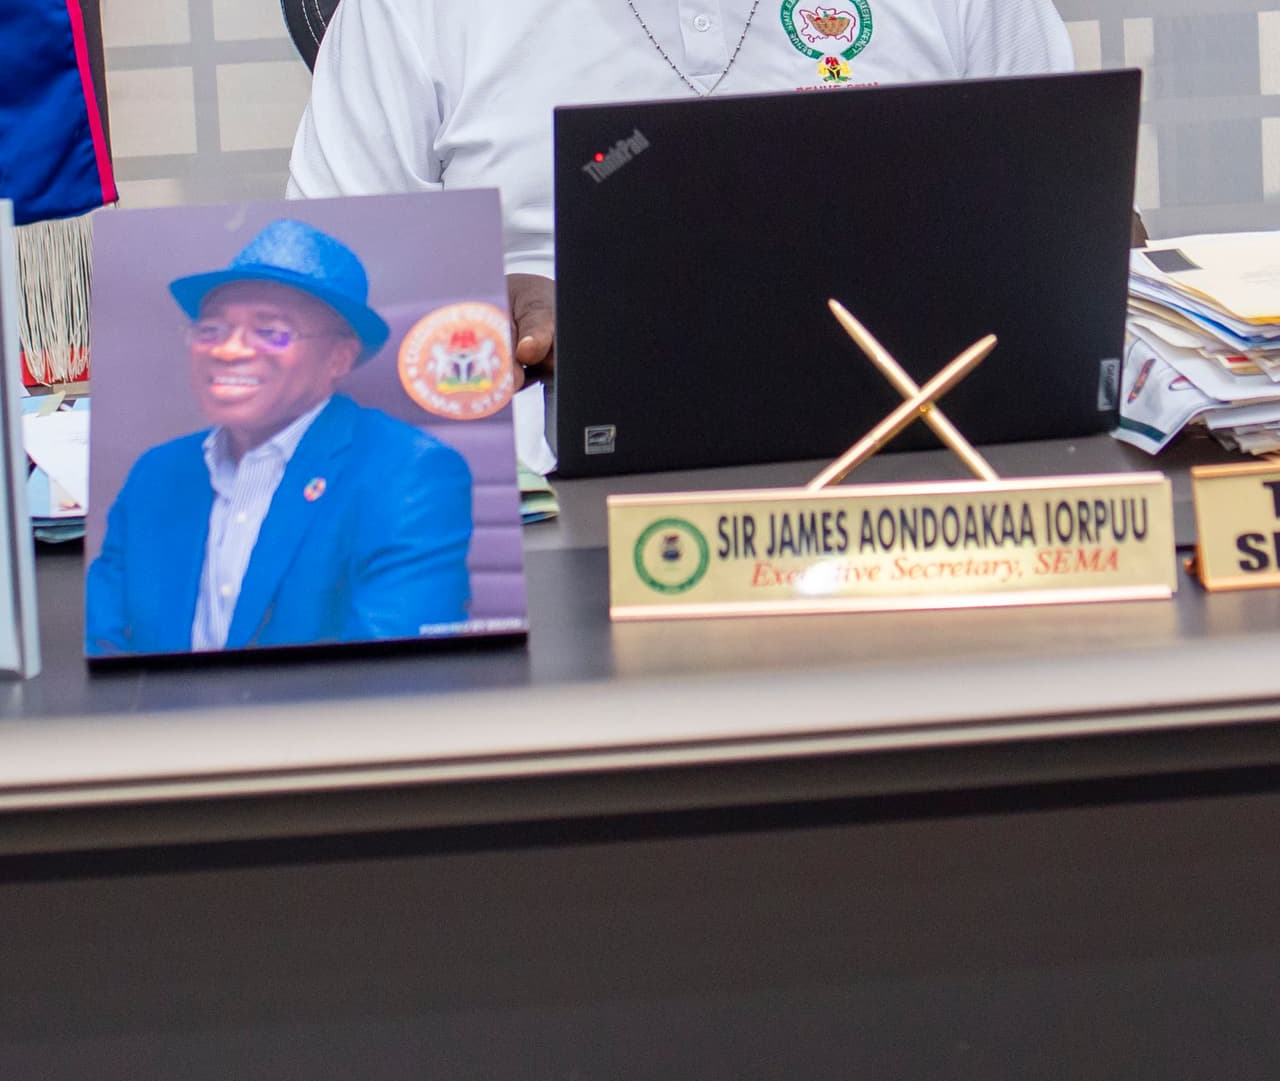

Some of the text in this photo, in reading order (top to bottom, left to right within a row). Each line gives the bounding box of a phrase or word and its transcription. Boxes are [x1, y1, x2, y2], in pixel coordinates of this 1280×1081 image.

[716, 496, 1150, 561] SIR JAMES AONDOAKAA IORPUU
[1033, 548, 1120, 576] SEMA
